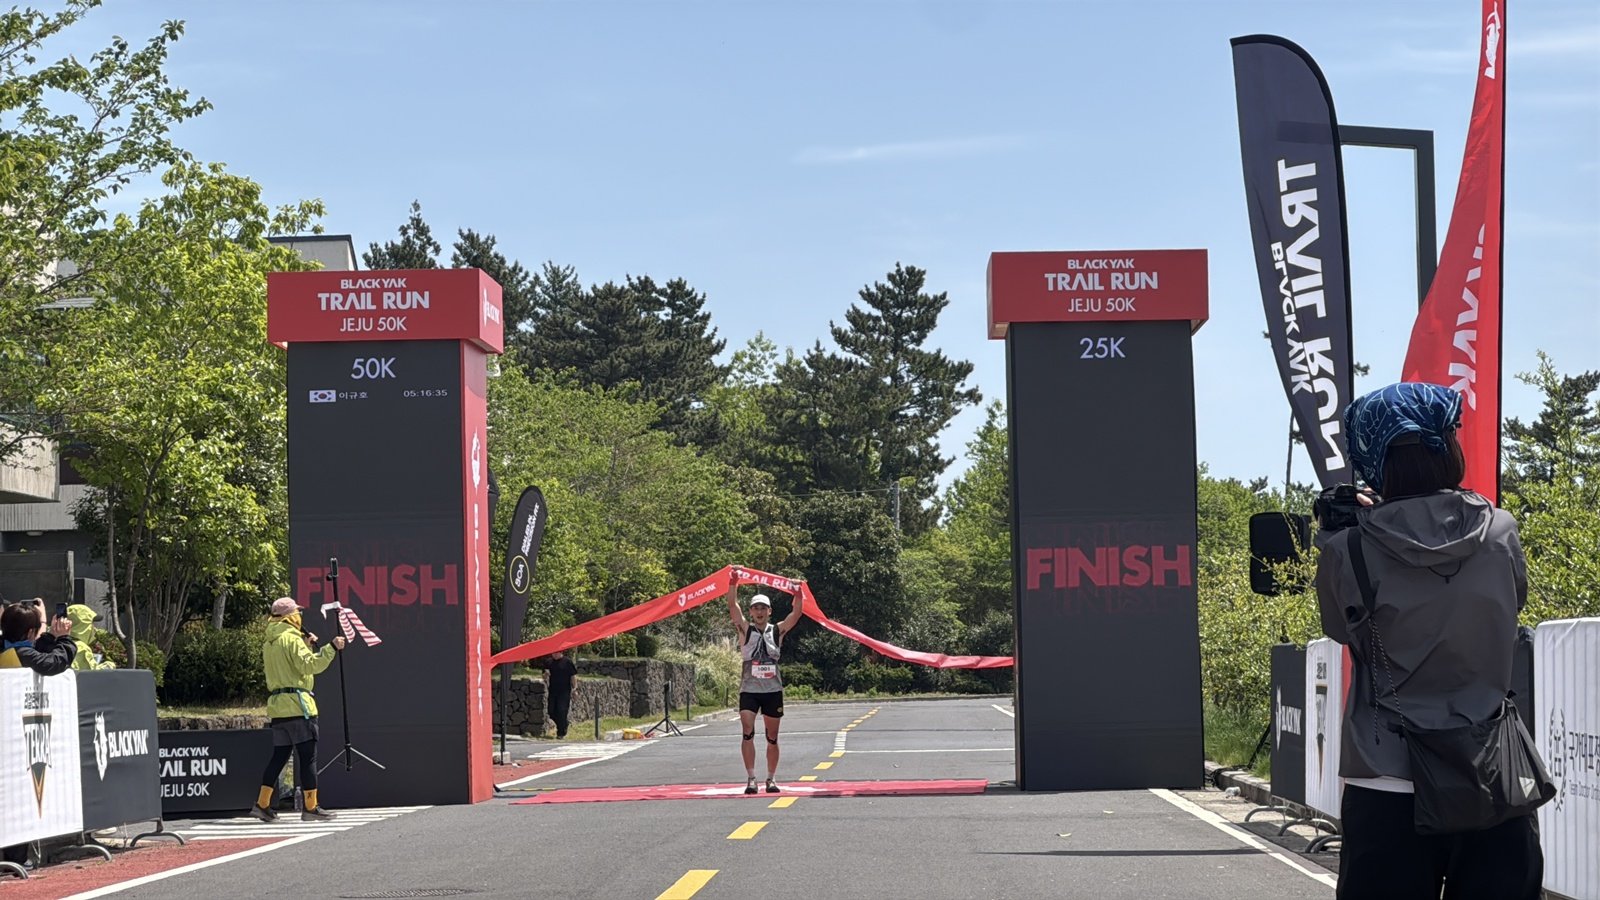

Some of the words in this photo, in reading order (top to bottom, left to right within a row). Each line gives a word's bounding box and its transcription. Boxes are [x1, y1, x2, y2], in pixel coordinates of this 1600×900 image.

[1044, 272, 1105, 291] TRAIL
[1110, 271, 1159, 290] RUN
[317, 292, 377, 311] TRAIL
[382, 290, 430, 310] RUN
[1067, 298, 1102, 313] JEJU
[1105, 297, 1137, 312] 50K
[340, 317, 373, 332] JEJU
[377, 316, 407, 331] 50K
[1080, 336, 1126, 359] 25K
[351, 357, 396, 379] 50K
[403, 389, 448, 398] 05:16:35
[515, 563, 525, 588] BOA
[1026, 544, 1192, 590] FINISH
[297, 565, 457, 607] FINISH
[24, 722, 51, 771] TERRA
[190, 758, 227, 777] RUN
[159, 783, 184, 798] JEJU
[187, 782, 210, 797] 50K
